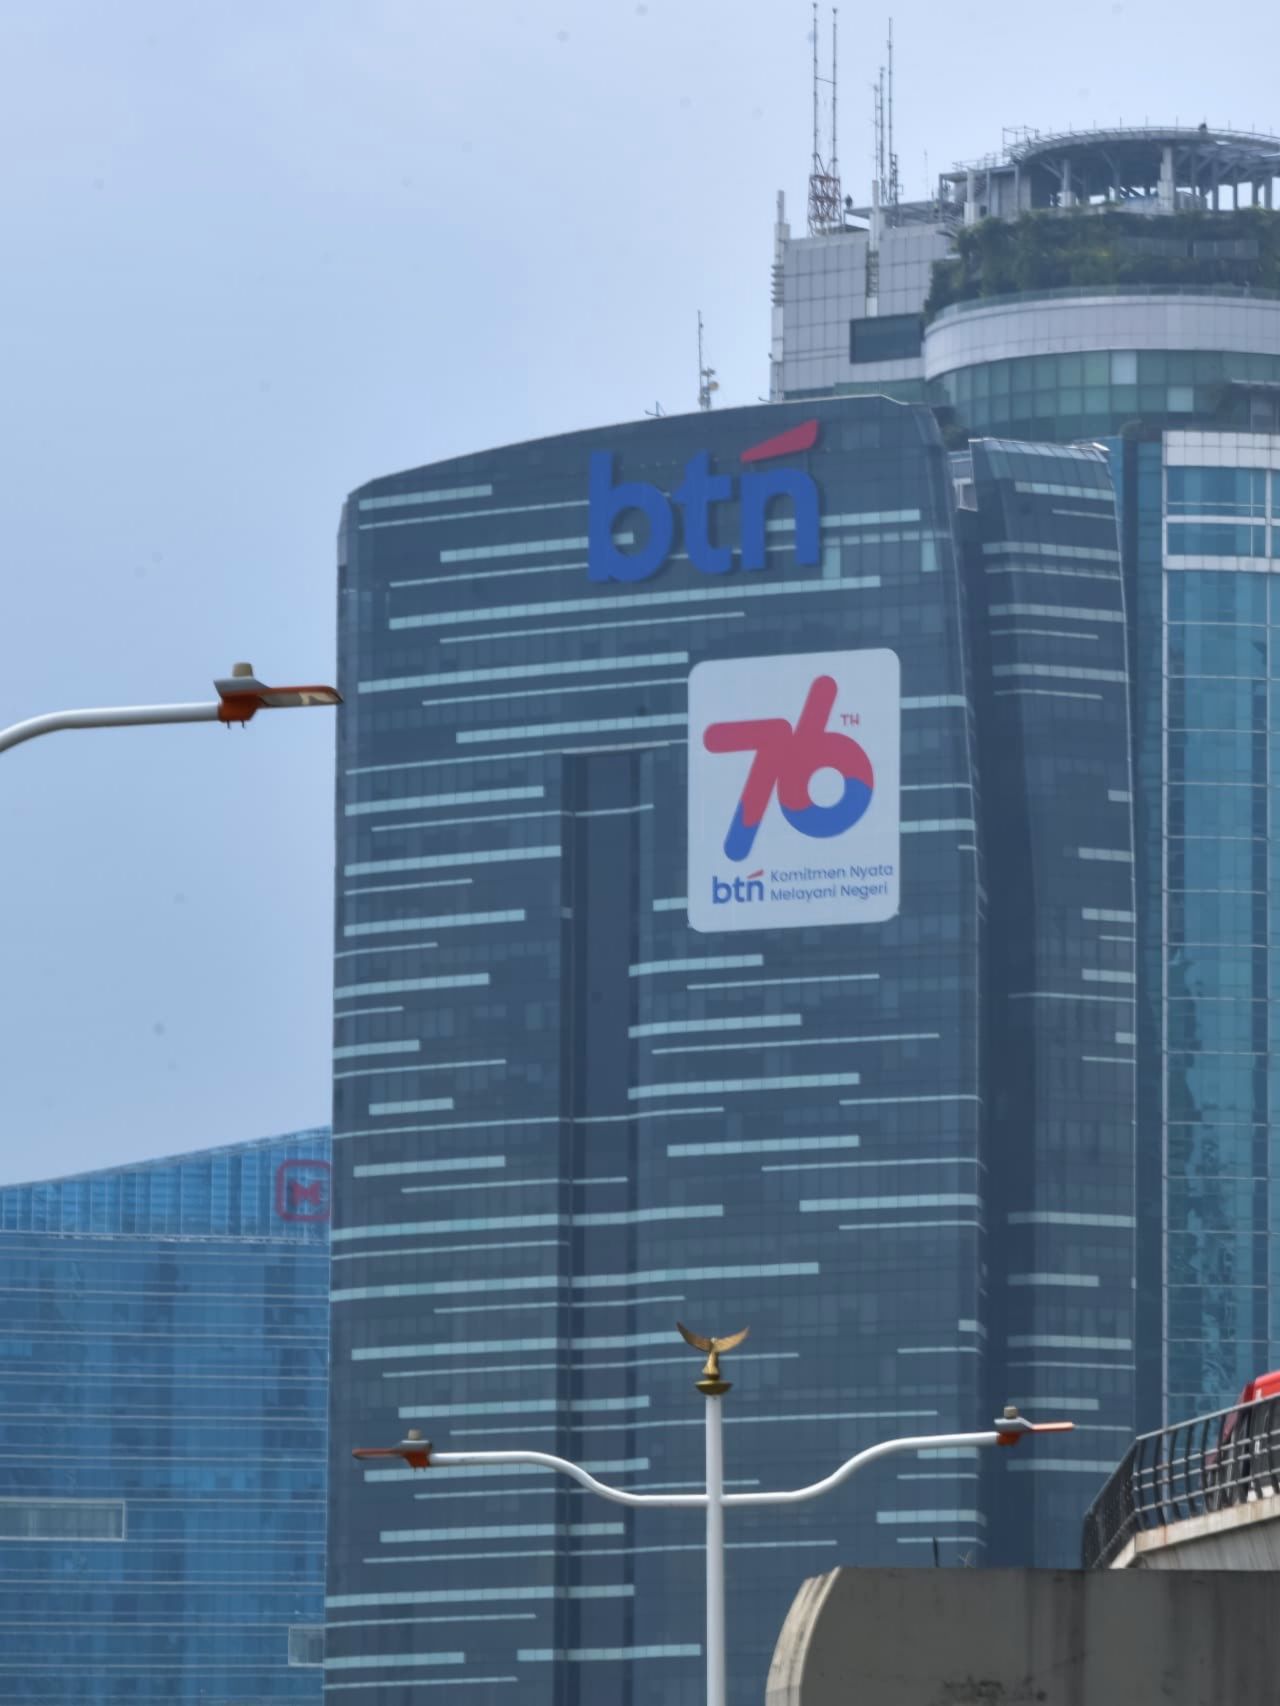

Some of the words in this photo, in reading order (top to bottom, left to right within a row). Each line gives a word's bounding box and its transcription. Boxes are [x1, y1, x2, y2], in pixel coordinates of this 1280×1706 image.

[703, 675, 874, 862] 76
[840, 713, 860, 727] TH
[770, 866, 846, 883] Komitmen
[849, 864, 894, 880] Nyata
[770, 883, 837, 902] Melayani
[840, 881, 888, 901] Negeri
